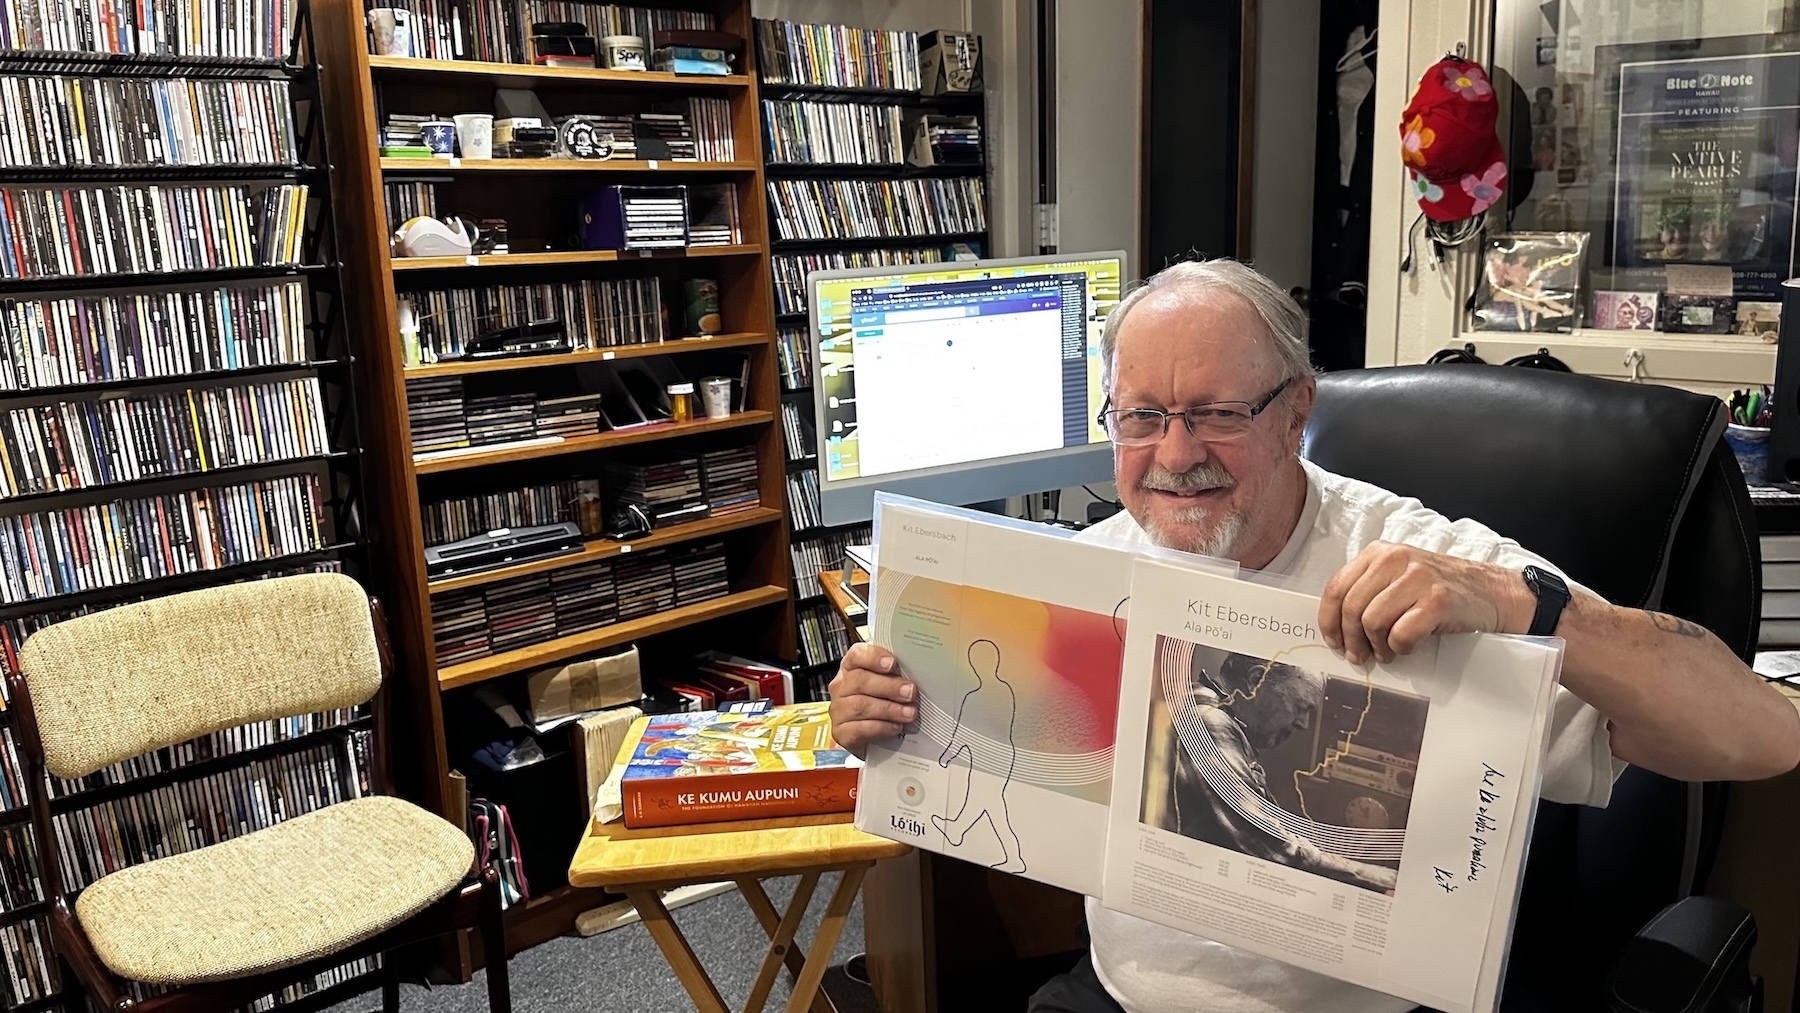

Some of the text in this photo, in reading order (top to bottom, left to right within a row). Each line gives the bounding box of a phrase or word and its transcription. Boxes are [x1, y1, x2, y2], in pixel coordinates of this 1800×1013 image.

[1666, 74, 1753, 90] Blue Note
[1678, 106, 1740, 116] FEATURING
[1692, 141, 1720, 152] THE
[1672, 150, 1742, 165] NATIVE
[1670, 164, 1741, 179] PEARLS
[902, 524, 956, 542] Kit Ebersbach
[1184, 620, 1202, 634] Ala
[1186, 598, 1316, 641] Kit Ebersbach
[678, 787, 799, 806] KE KUMU AUPUNI
